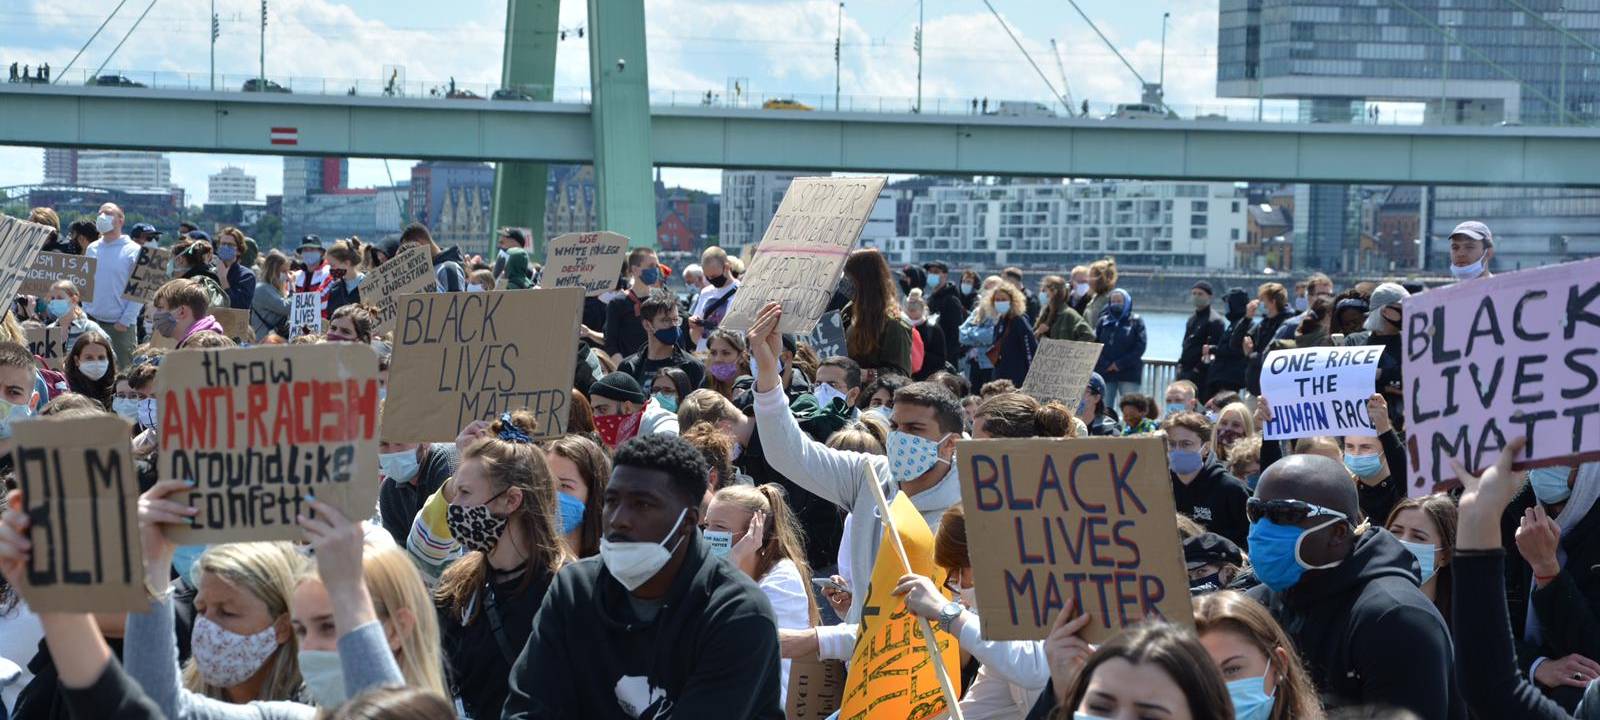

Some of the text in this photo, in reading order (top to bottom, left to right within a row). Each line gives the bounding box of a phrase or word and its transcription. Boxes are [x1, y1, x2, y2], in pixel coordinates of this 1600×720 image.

[579, 234, 598, 244] USE
[295, 293, 315, 309] BLACK
[381, 261, 430, 297] UNDERSTAND
[294, 308, 315, 325] LIVES
[402, 294, 504, 345] BLACK
[1407, 282, 1600, 365] BLACK
[202, 351, 293, 385] throw
[438, 343, 520, 393] LIVES
[1270, 349, 1380, 375] ONE RACE
[1294, 374, 1338, 398] THE
[1412, 347, 1600, 424] LIVES
[162, 378, 378, 450] ANTI-RACISM
[1266, 401, 1330, 436] HUMAN
[970, 451, 1148, 516] BLACK
[18, 446, 132, 586] BLM
[1014, 515, 1141, 570] LIVES
[1004, 568, 1168, 630] MATTER
